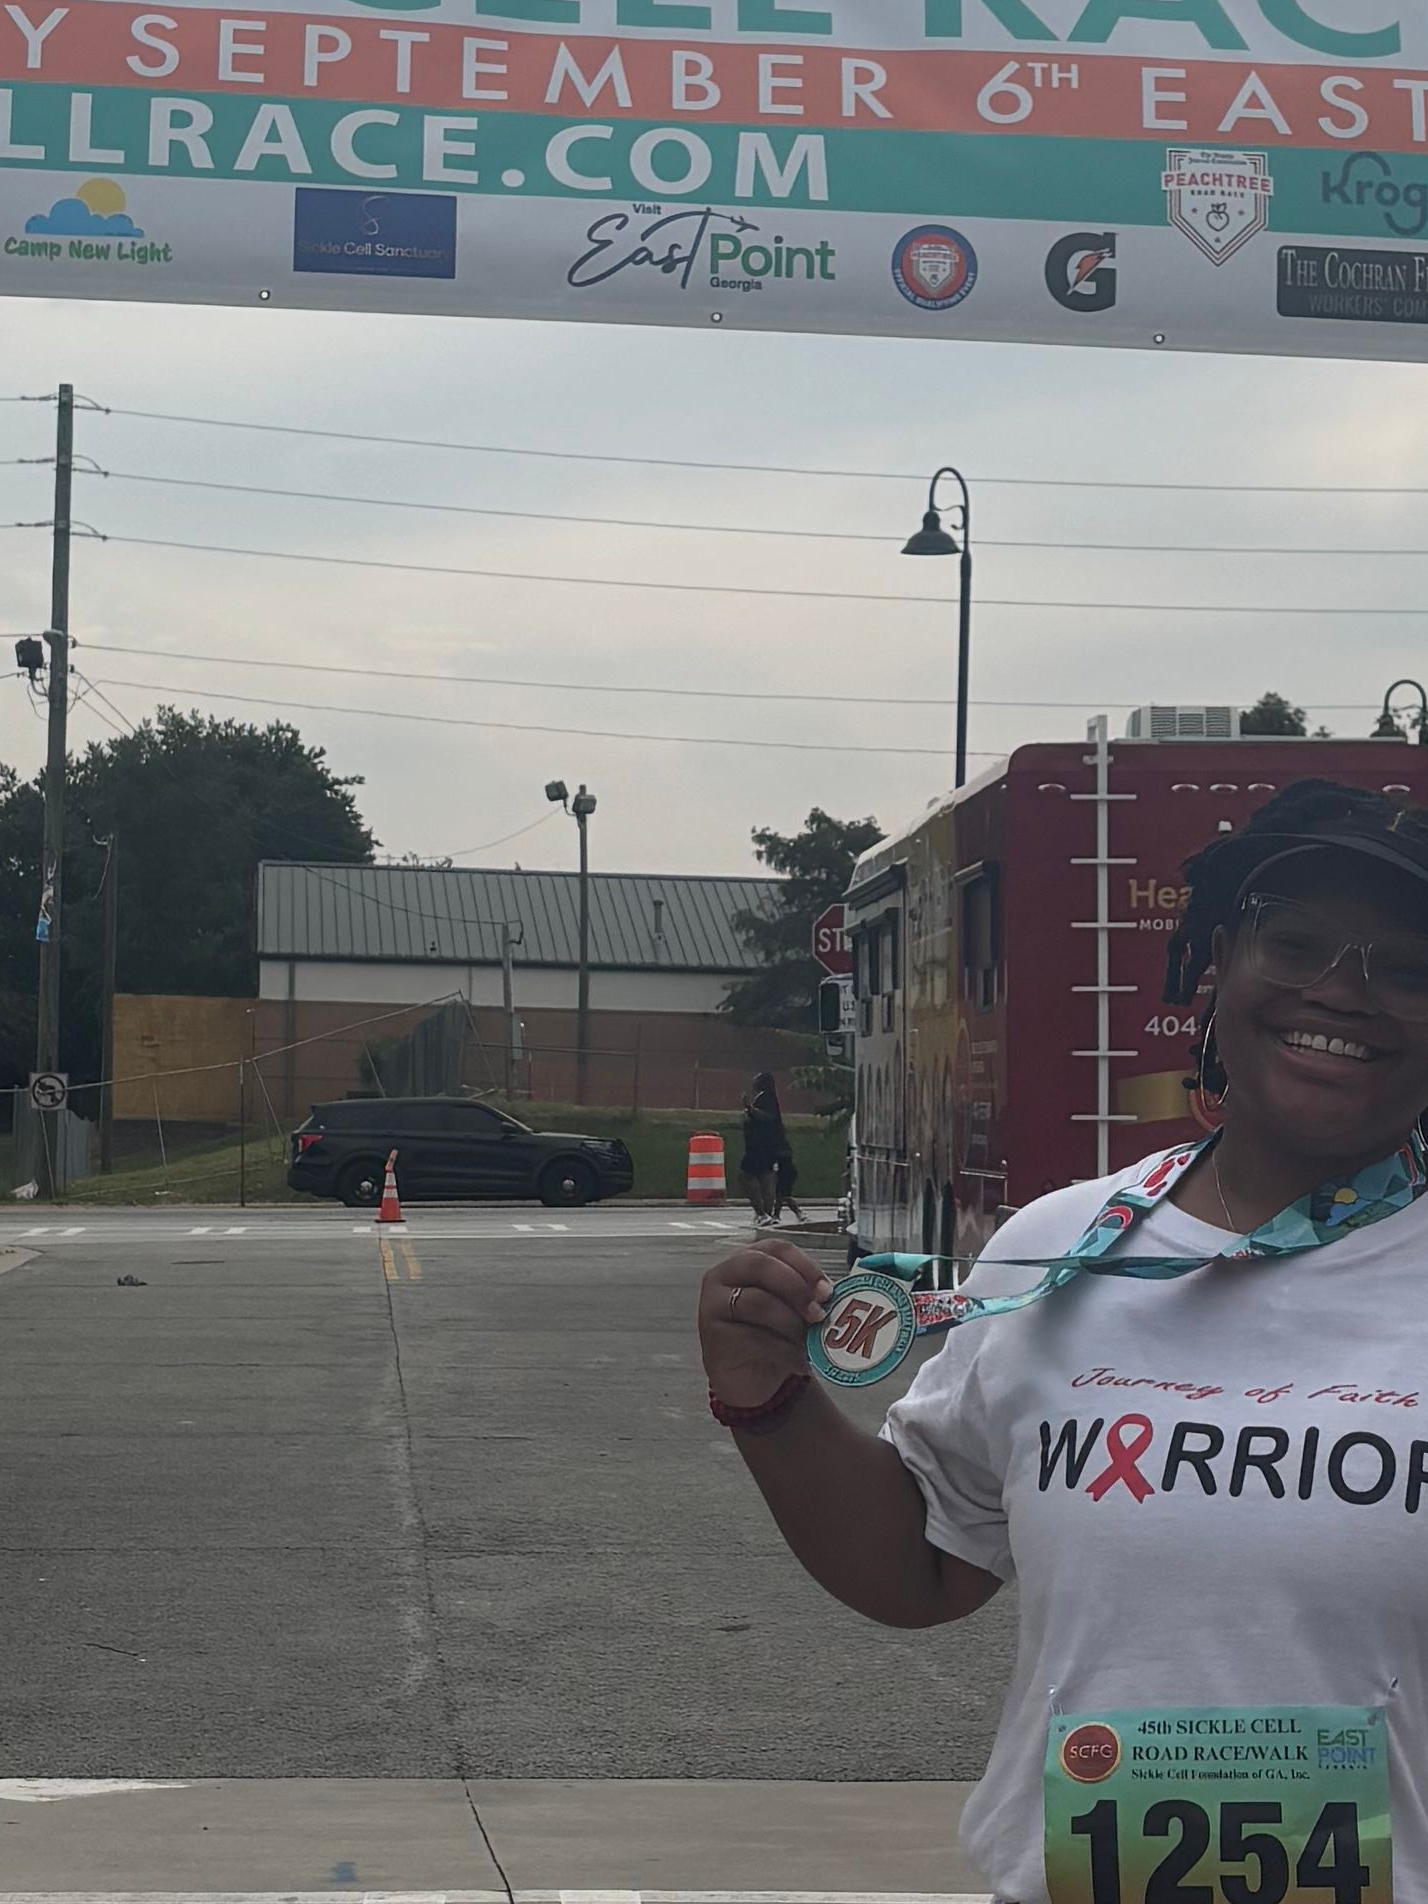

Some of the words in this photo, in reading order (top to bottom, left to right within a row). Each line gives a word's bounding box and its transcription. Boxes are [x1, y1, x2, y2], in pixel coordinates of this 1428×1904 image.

[126, 13, 894, 120] SEPTEMBER
[975, 60, 1080, 126] 6TH
[1163, 171, 1273, 193] PEACHTREE
[632, 202, 662, 217] Visit
[3, 236, 63, 261] Camp
[68, 240, 112, 261] New
[116, 241, 174, 265] Light
[343, 241, 373, 257] Cell
[374, 243, 446, 261] Sanctuar
[566, 206, 715, 290] East
[709, 232, 837, 281] Point
[1282, 249, 1318, 287] THE
[1324, 252, 1407, 292] COCHRAN
[709, 276, 763, 293] Georgia
[823, 1297, 898, 1360] 5K
[1071, 1367, 1224, 1400] Journey
[1244, 1383, 1294, 1404] of
[1307, 1384, 1420, 1408] Faith
[1137, 1719, 1172, 1736] 45th
[1176, 1719, 1246, 1735] SICKLE
[1250, 1718, 1303, 1735] CELL
[1317, 1729, 1369, 1747] EAST
[1069, 1744, 1113, 1759] SCFG
[1131, 1746, 1189, 1762] ROAD
[1193, 1745, 1309, 1763] RACE/WALK
[1317, 1747, 1377, 1766] POINT
[1131, 1769, 1165, 1781] Sickle
[1167, 1769, 1189, 1781] Cell
[1191, 1769, 1250, 1780] Foundation
[1252, 1769, 1263, 1780] of
[1290, 1769, 1311, 1781] Inc.
